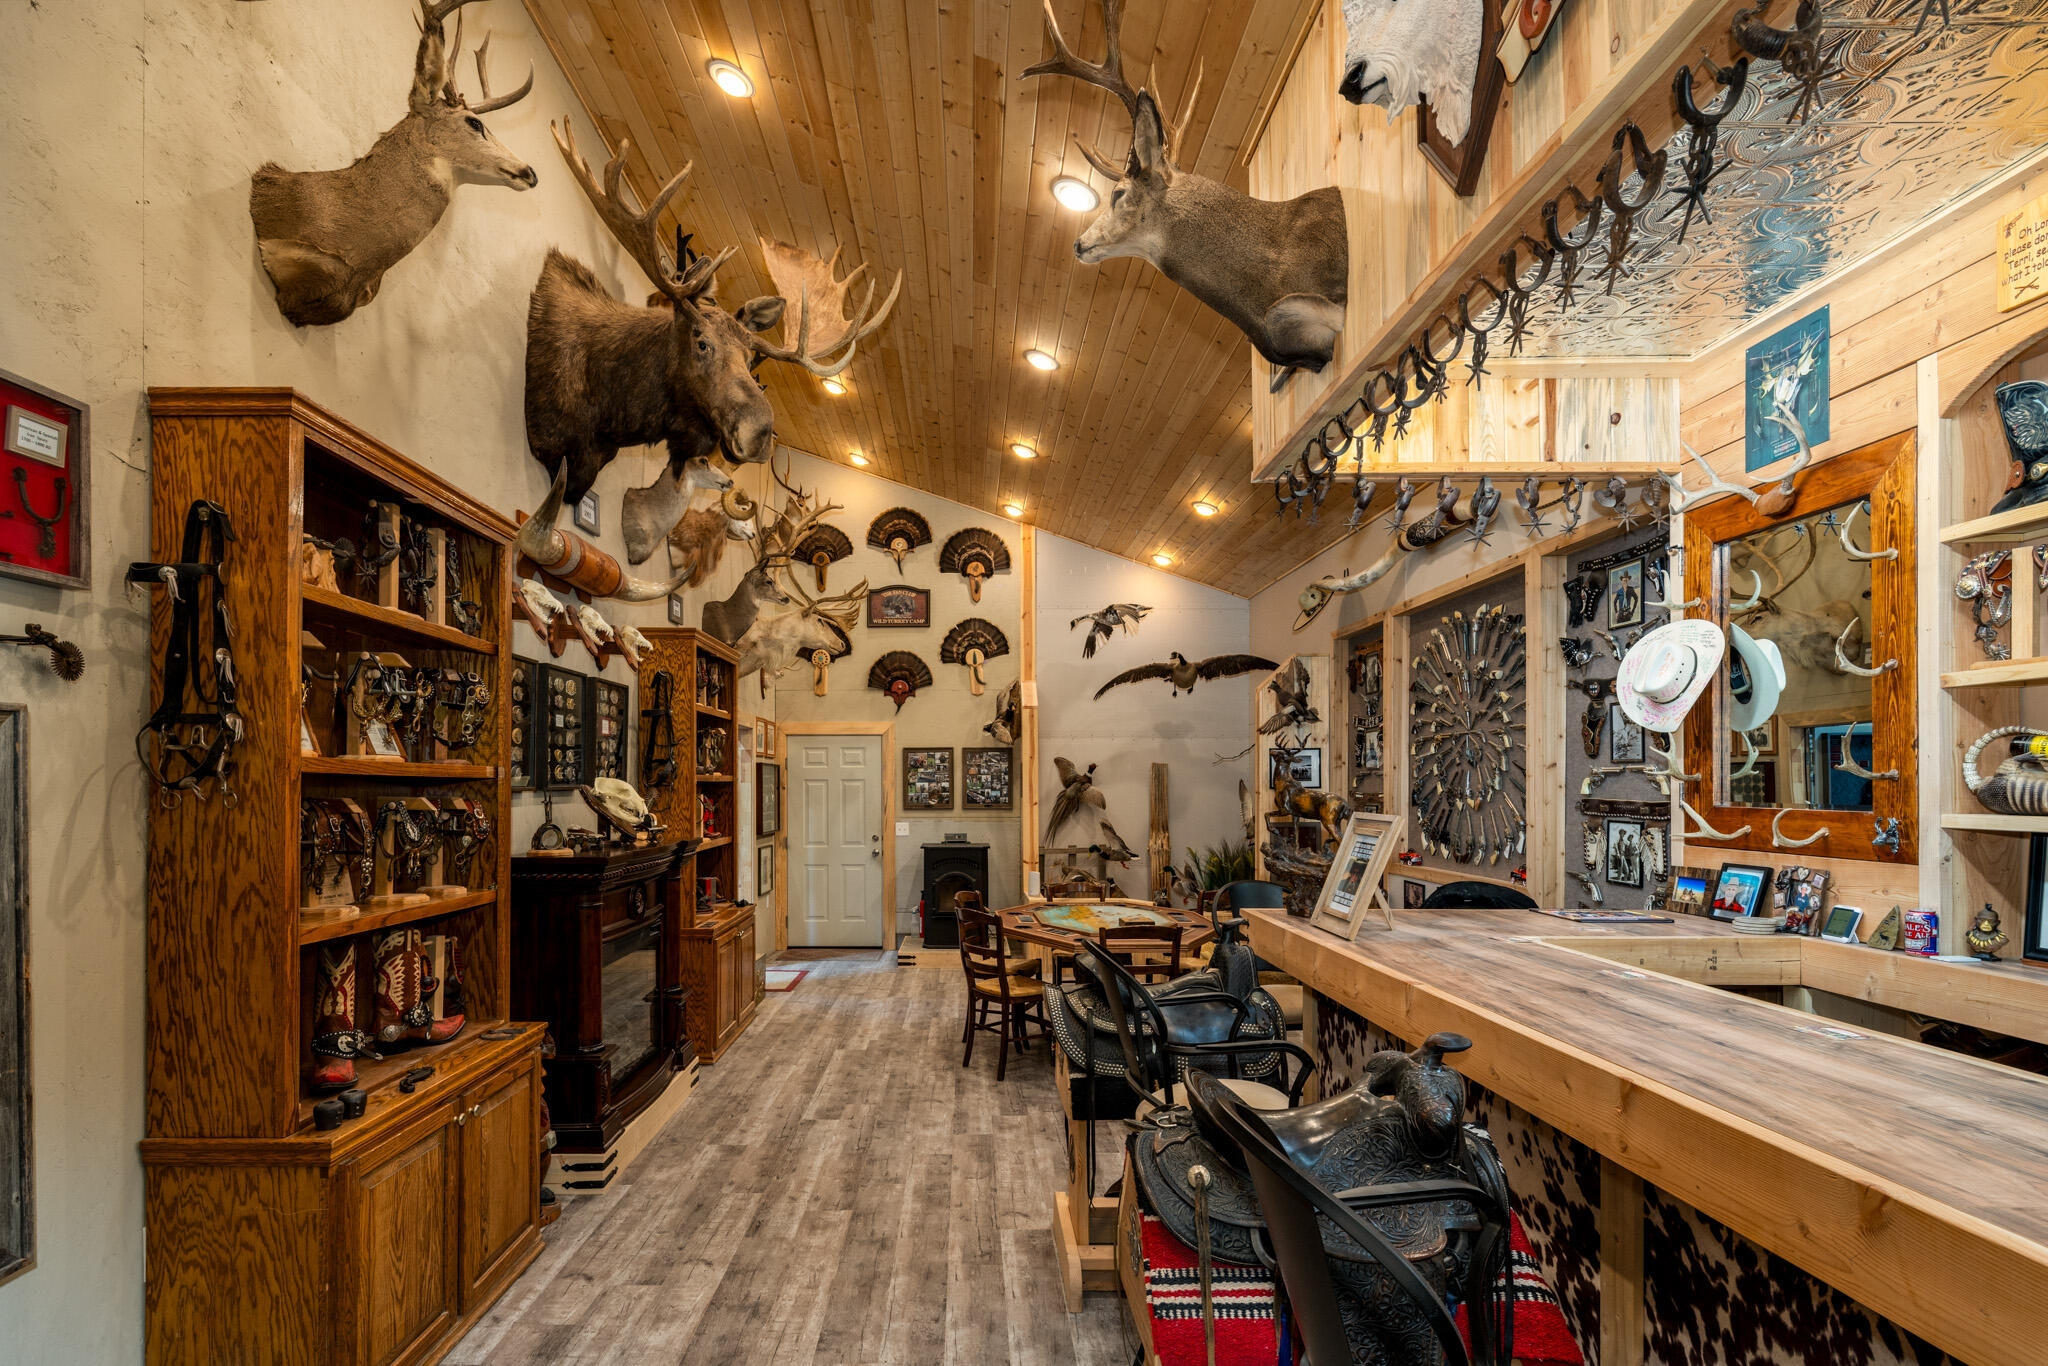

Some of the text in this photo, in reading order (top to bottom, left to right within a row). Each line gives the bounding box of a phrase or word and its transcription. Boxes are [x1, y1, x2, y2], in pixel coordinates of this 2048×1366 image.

[2019, 219, 2048, 239] Oh Lor
[2004, 241, 2032, 263] please
[2008, 246, 2048, 269] Terri, se
[2001, 269, 2023, 287] what
[2024, 265, 2031, 276] I
[1905, 923, 1931, 933] ALE'S
